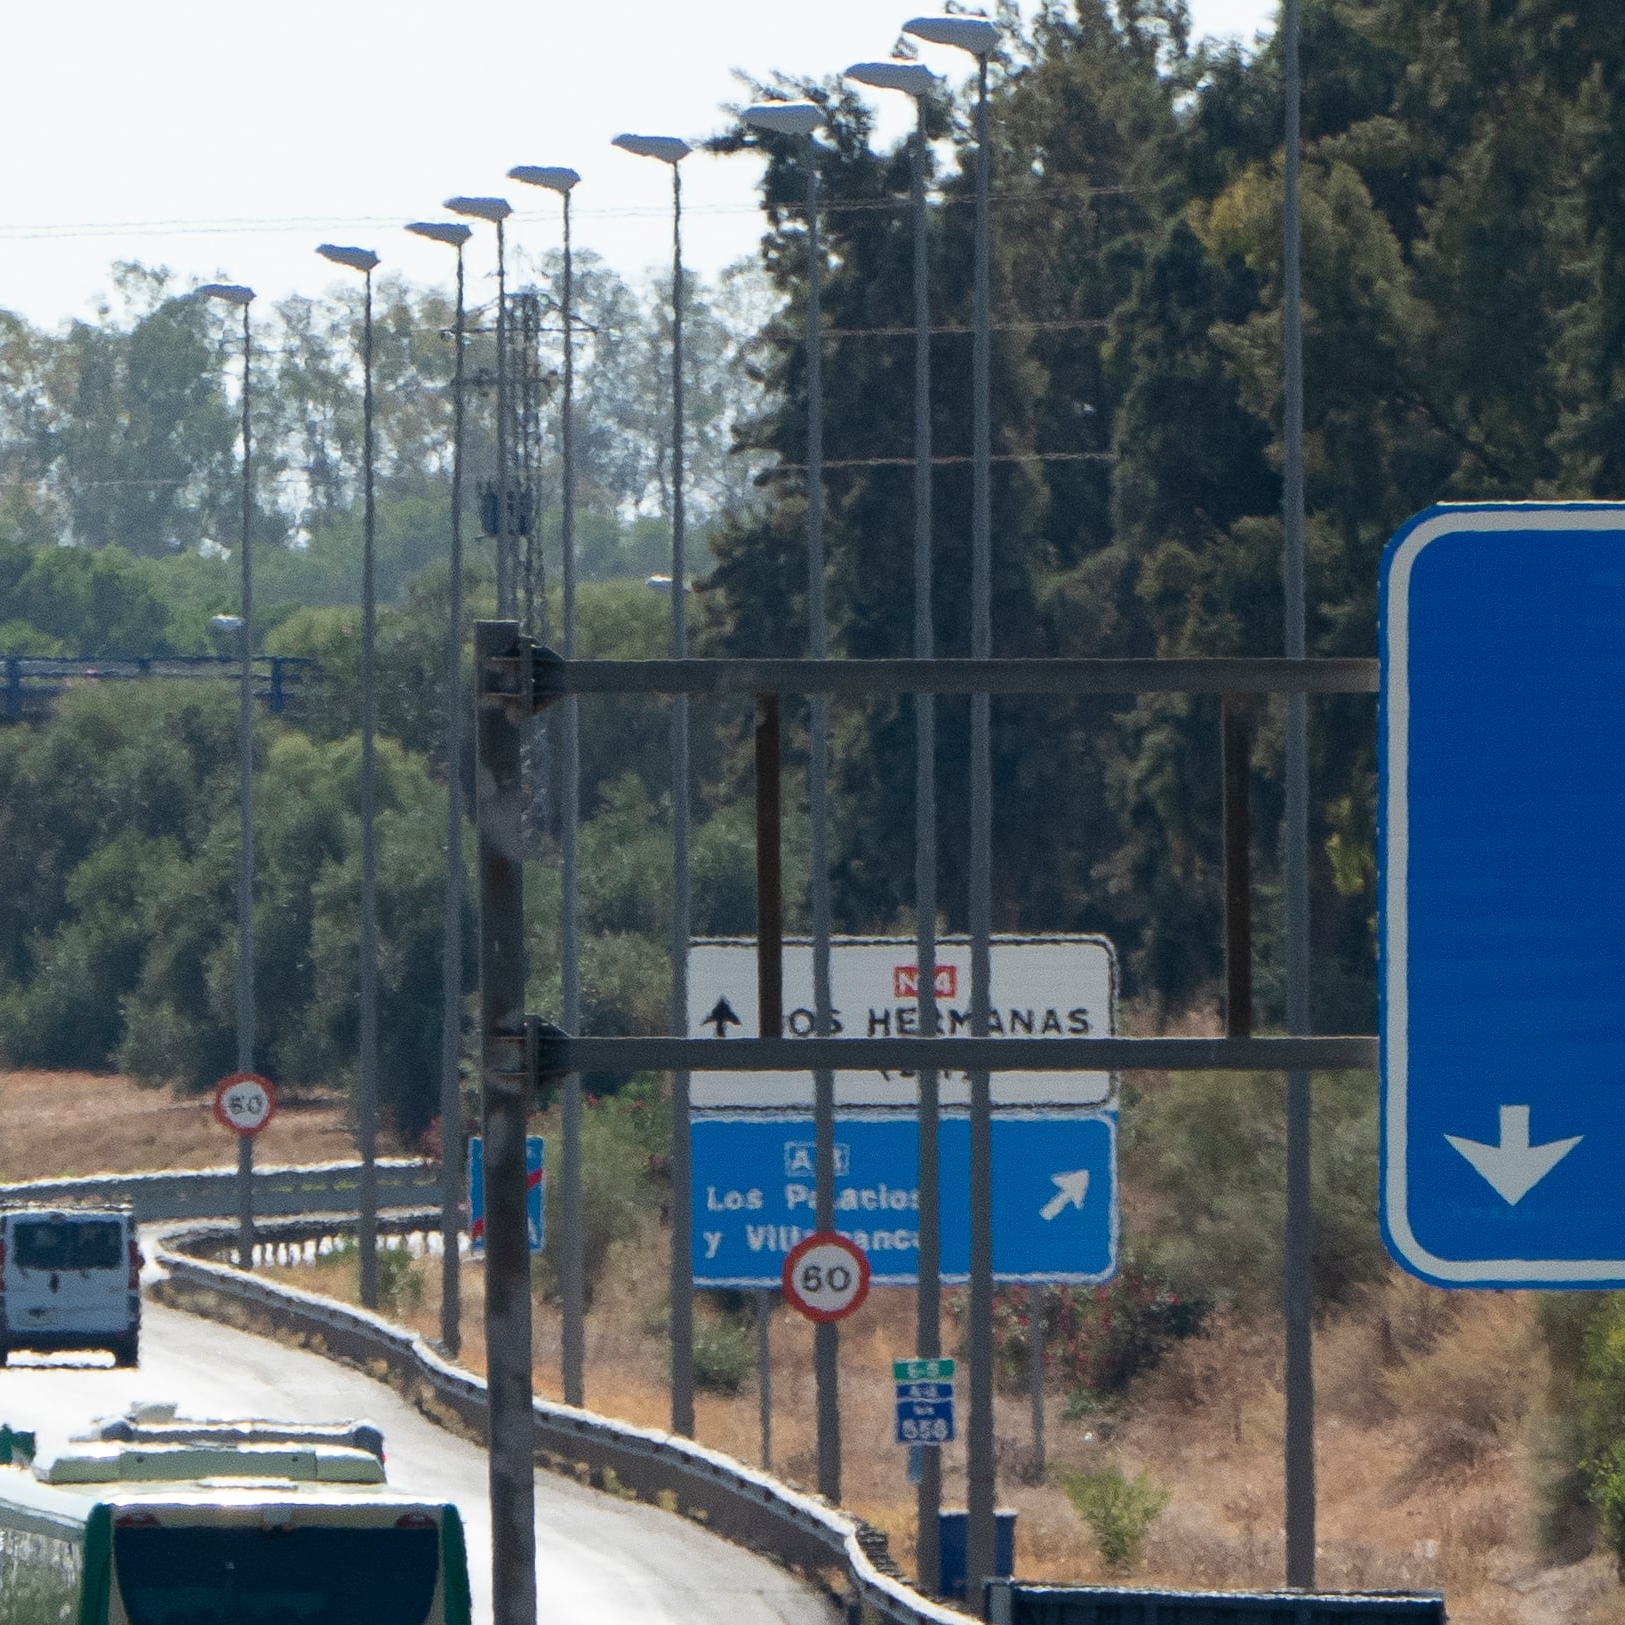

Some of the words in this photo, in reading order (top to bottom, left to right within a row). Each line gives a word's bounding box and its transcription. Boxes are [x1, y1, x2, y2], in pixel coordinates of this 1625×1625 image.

[780, 1008, 843, 1037] OS
[868, 1006, 1090, 1038] HEMANAS
[707, 1186, 764, 1211] Los
[703, 1231, 722, 1259] y
[802, 1265, 852, 1293] 60
